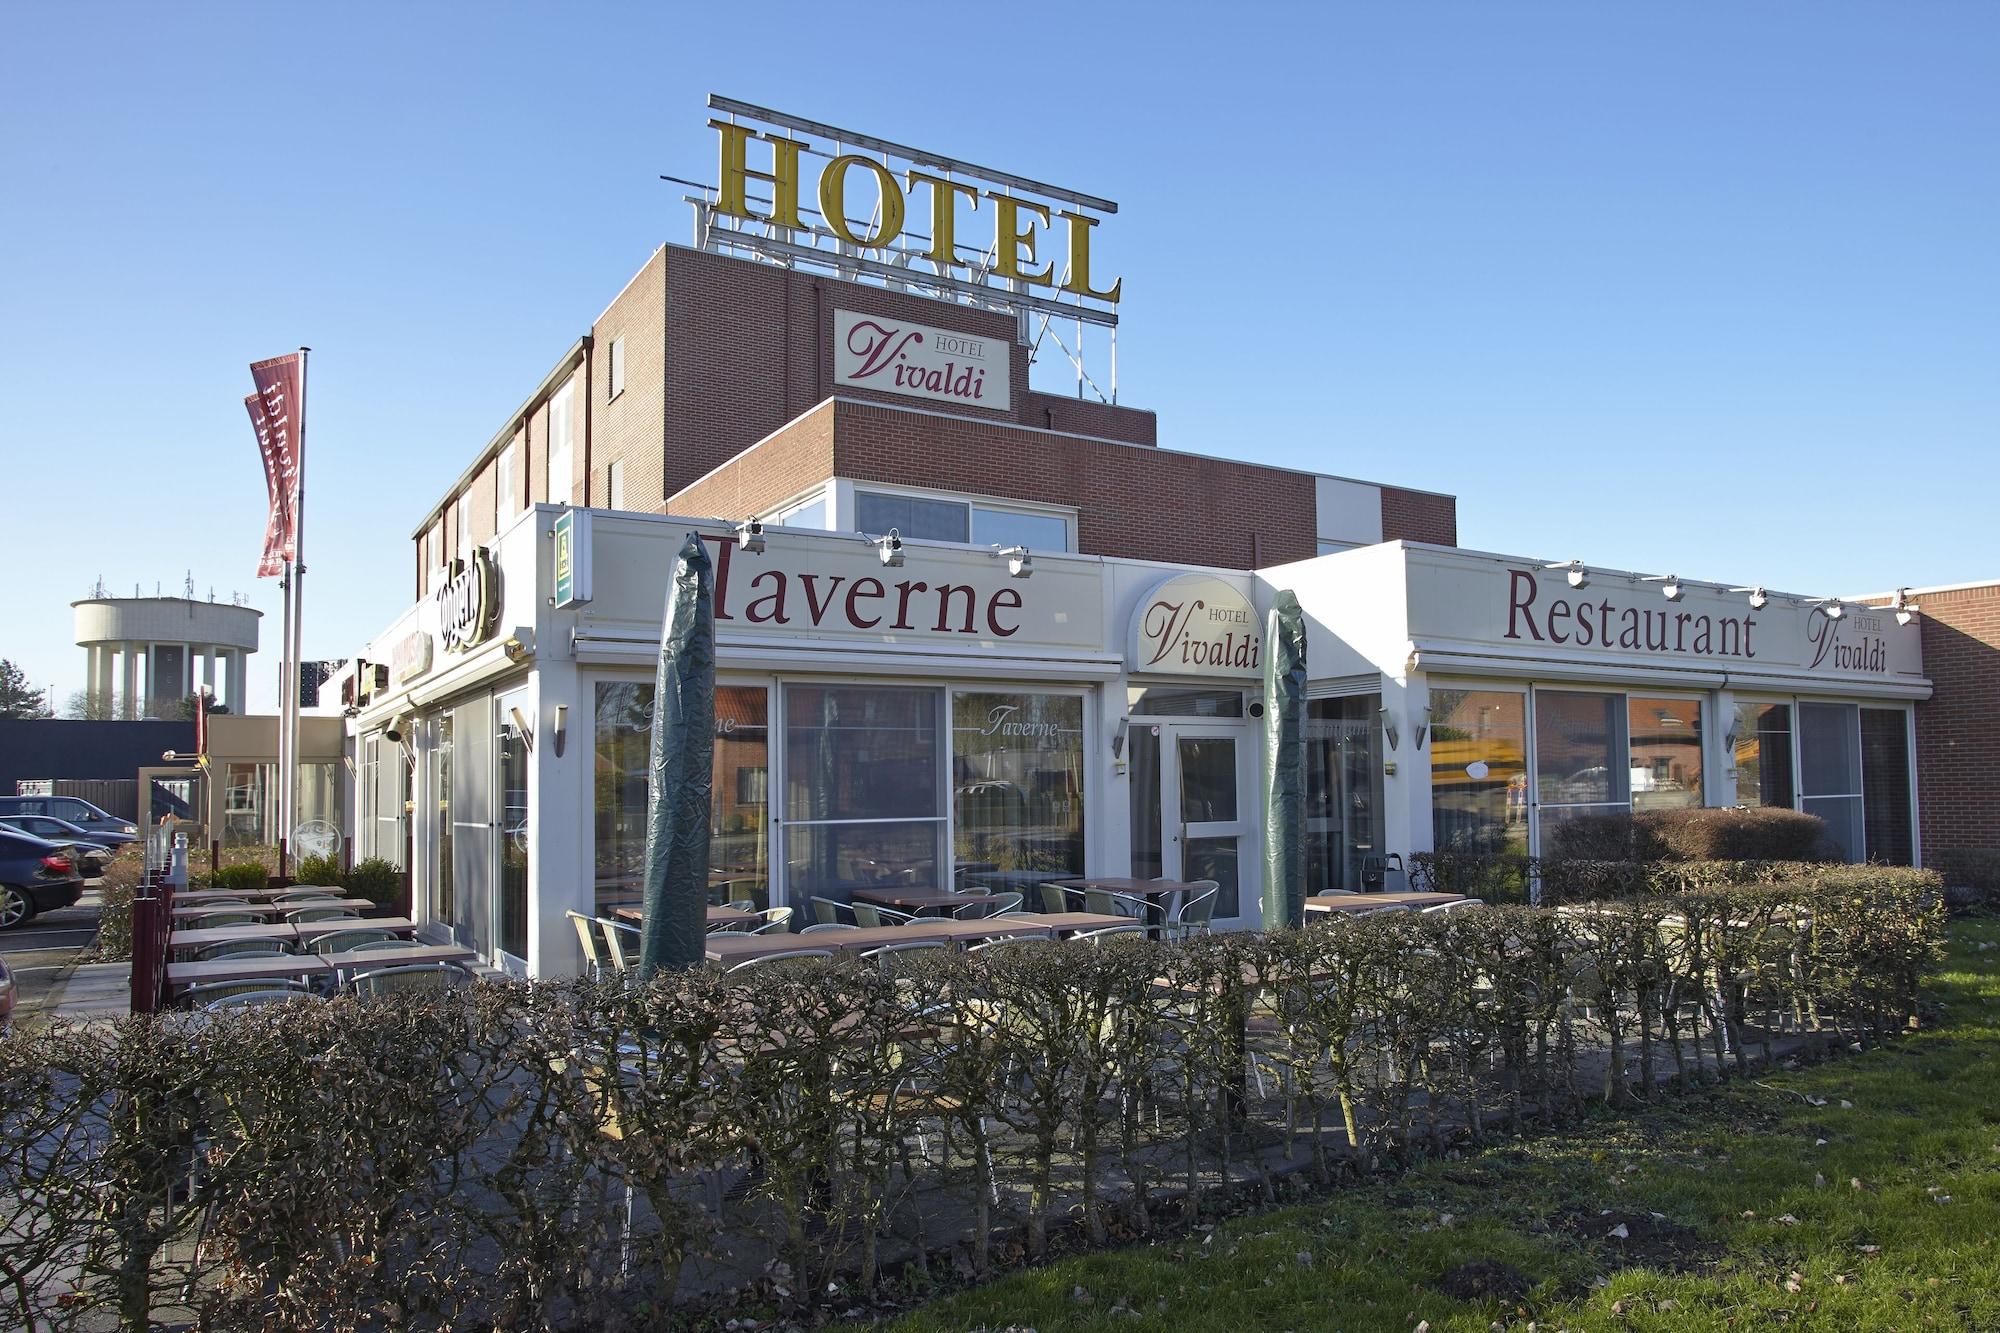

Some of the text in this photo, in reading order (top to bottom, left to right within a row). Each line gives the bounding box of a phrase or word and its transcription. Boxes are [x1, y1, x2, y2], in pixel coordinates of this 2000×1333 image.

[707, 119, 1121, 302] HOTEL
[847, 320, 986, 400] Vivaldi
[935, 336, 984, 357] HOTEL
[700, 535, 1022, 637] Taverne
[1209, 608, 1249, 624] HOTEL
[1504, 569, 1757, 658] Restaurant
[1145, 600, 1259, 669] Vivaldi
[1807, 608, 1886, 672] Vivaldi
[1854, 616, 1881, 632] HOTEL
[981, 705, 1058, 736] Taverne
